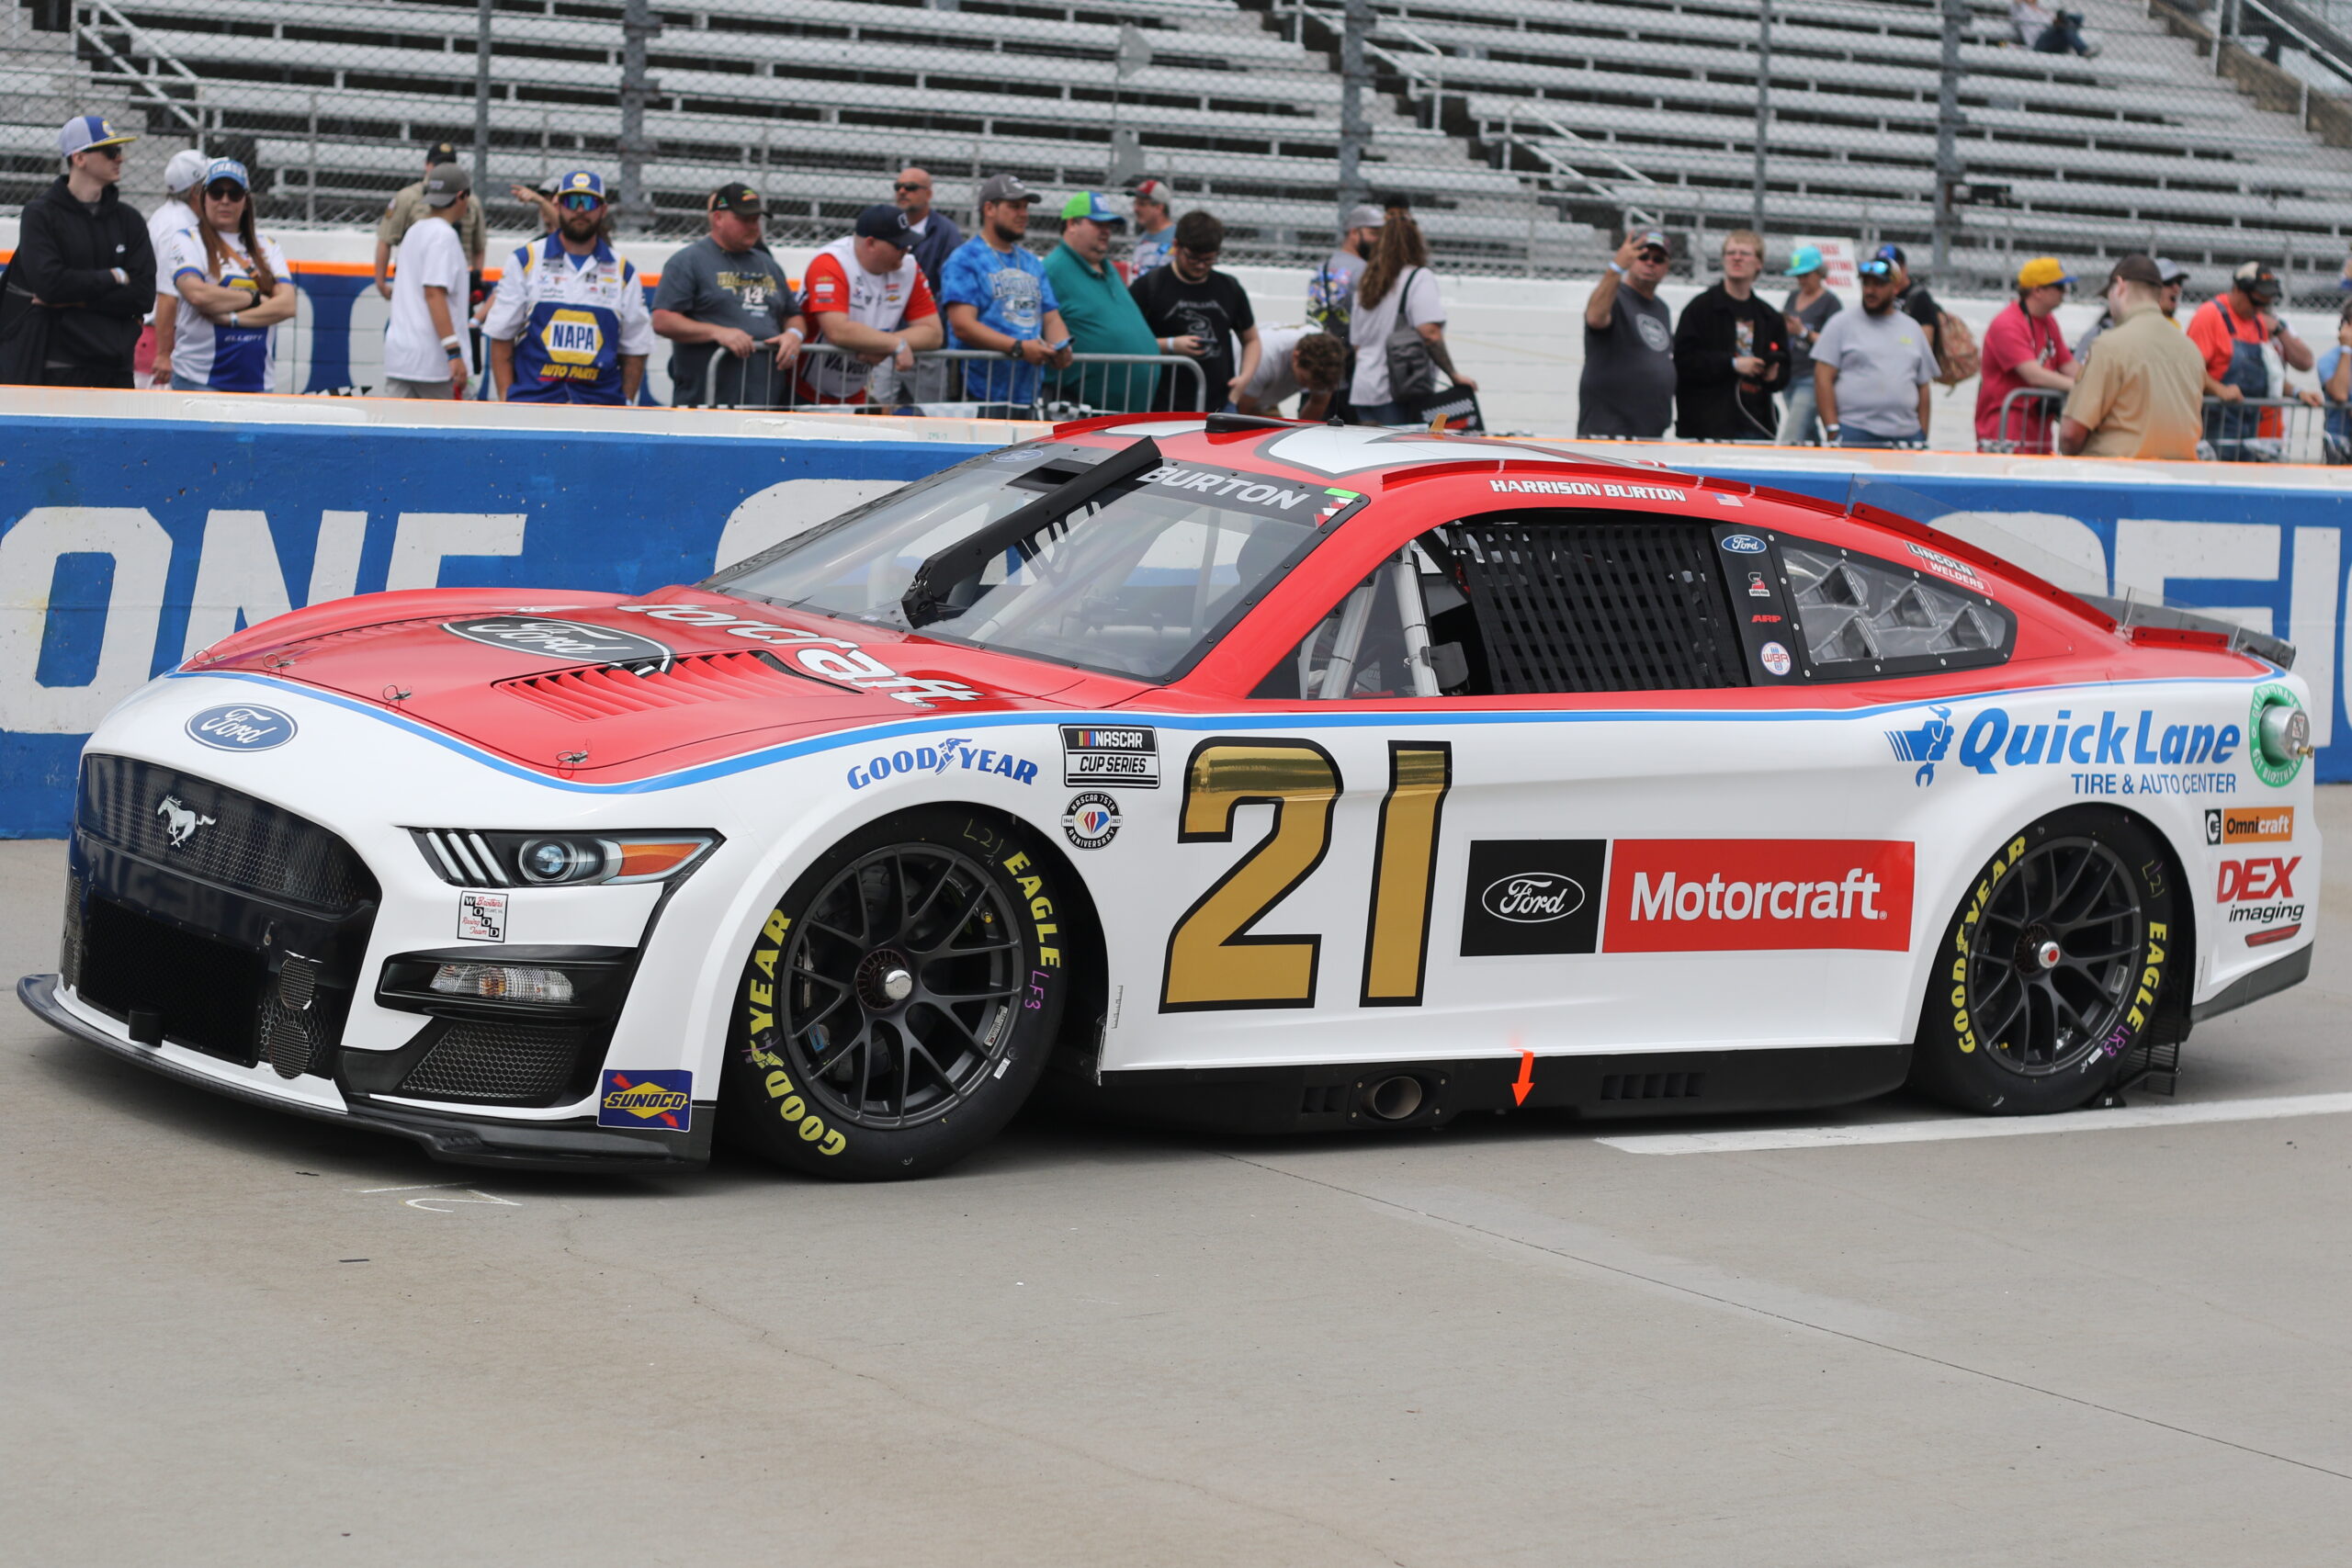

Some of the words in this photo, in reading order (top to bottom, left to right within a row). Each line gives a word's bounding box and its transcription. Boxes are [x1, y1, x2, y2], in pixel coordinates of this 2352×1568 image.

[551, 324, 595, 352] NAPA
[540, 364, 566, 378] AUTO
[1136, 466, 1311, 511] BURTON
[1489, 479, 1601, 497] HARRISON
[1603, 483, 1687, 502] BURTON
[1731, 536, 1759, 550] Ford
[1909, 544, 1973, 577] LINCOLN
[1930, 561, 1984, 591] WELDERS
[1751, 615, 1782, 623] ARP
[467, 622, 633, 654] Ford
[200, 707, 278, 744] Ford
[1095, 730, 1143, 749] NASCAR
[1080, 756, 1105, 773] CUP
[1105, 756, 1148, 773] SERIES
[2071, 773, 2117, 795] TIRE
[2121, 773, 2134, 795] &
[2140, 773, 2180, 795] AUTO
[2182, 773, 2236, 794] CENTER
[1070, 794, 1098, 811] NASCAR
[1099, 795, 1115, 811] 75TH
[2226, 815, 2290, 835] Omnicraft
[1068, 828, 1115, 848] ANNIVERSARY
[1158, 736, 1453, 1014] 21
[2217, 855, 2302, 905] DEX
[476, 896, 503, 908] Brothers
[1499, 879, 1565, 913] Ford
[1629, 867, 1882, 921] Motorcraft
[1002, 851, 1061, 968] EAGLE
[2229, 901, 2305, 924] imaging
[469, 926, 488, 935] Team
[2126, 920, 2167, 1032] EAGLE
[606, 1093, 685, 1108] SUNOCO
